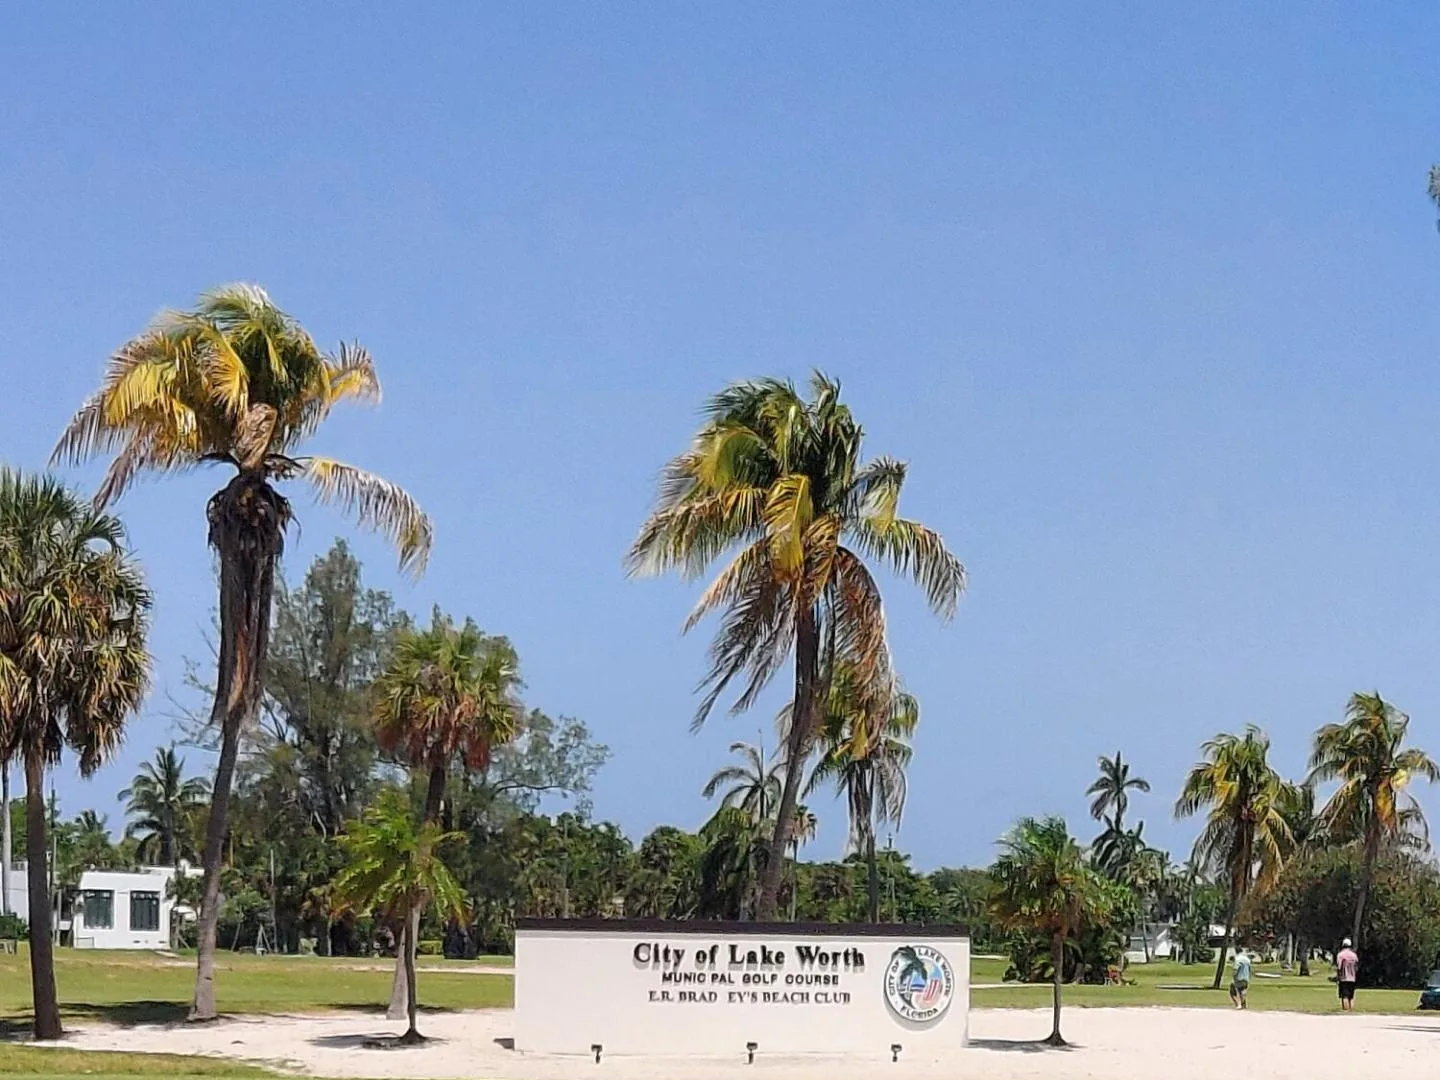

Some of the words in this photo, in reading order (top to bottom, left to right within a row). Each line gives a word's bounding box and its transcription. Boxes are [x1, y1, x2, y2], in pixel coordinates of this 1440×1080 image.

[633, 942, 685, 967] City
[695, 944, 719, 964] of
[728, 944, 785, 965] Lake
[795, 945, 865, 966] Worth
[661, 971, 735, 984] MUNICPAL
[742, 973, 778, 985] GOLF
[785, 974, 840, 986] COURSE
[888, 974, 896, 997] CITY
[917, 948, 943, 963] LAKE
[940, 961, 952, 997] WORTH
[762, 991, 811, 1004] BEACH
[814, 991, 851, 1004] CLUB
[900, 1003, 939, 1019] FLORIDA
